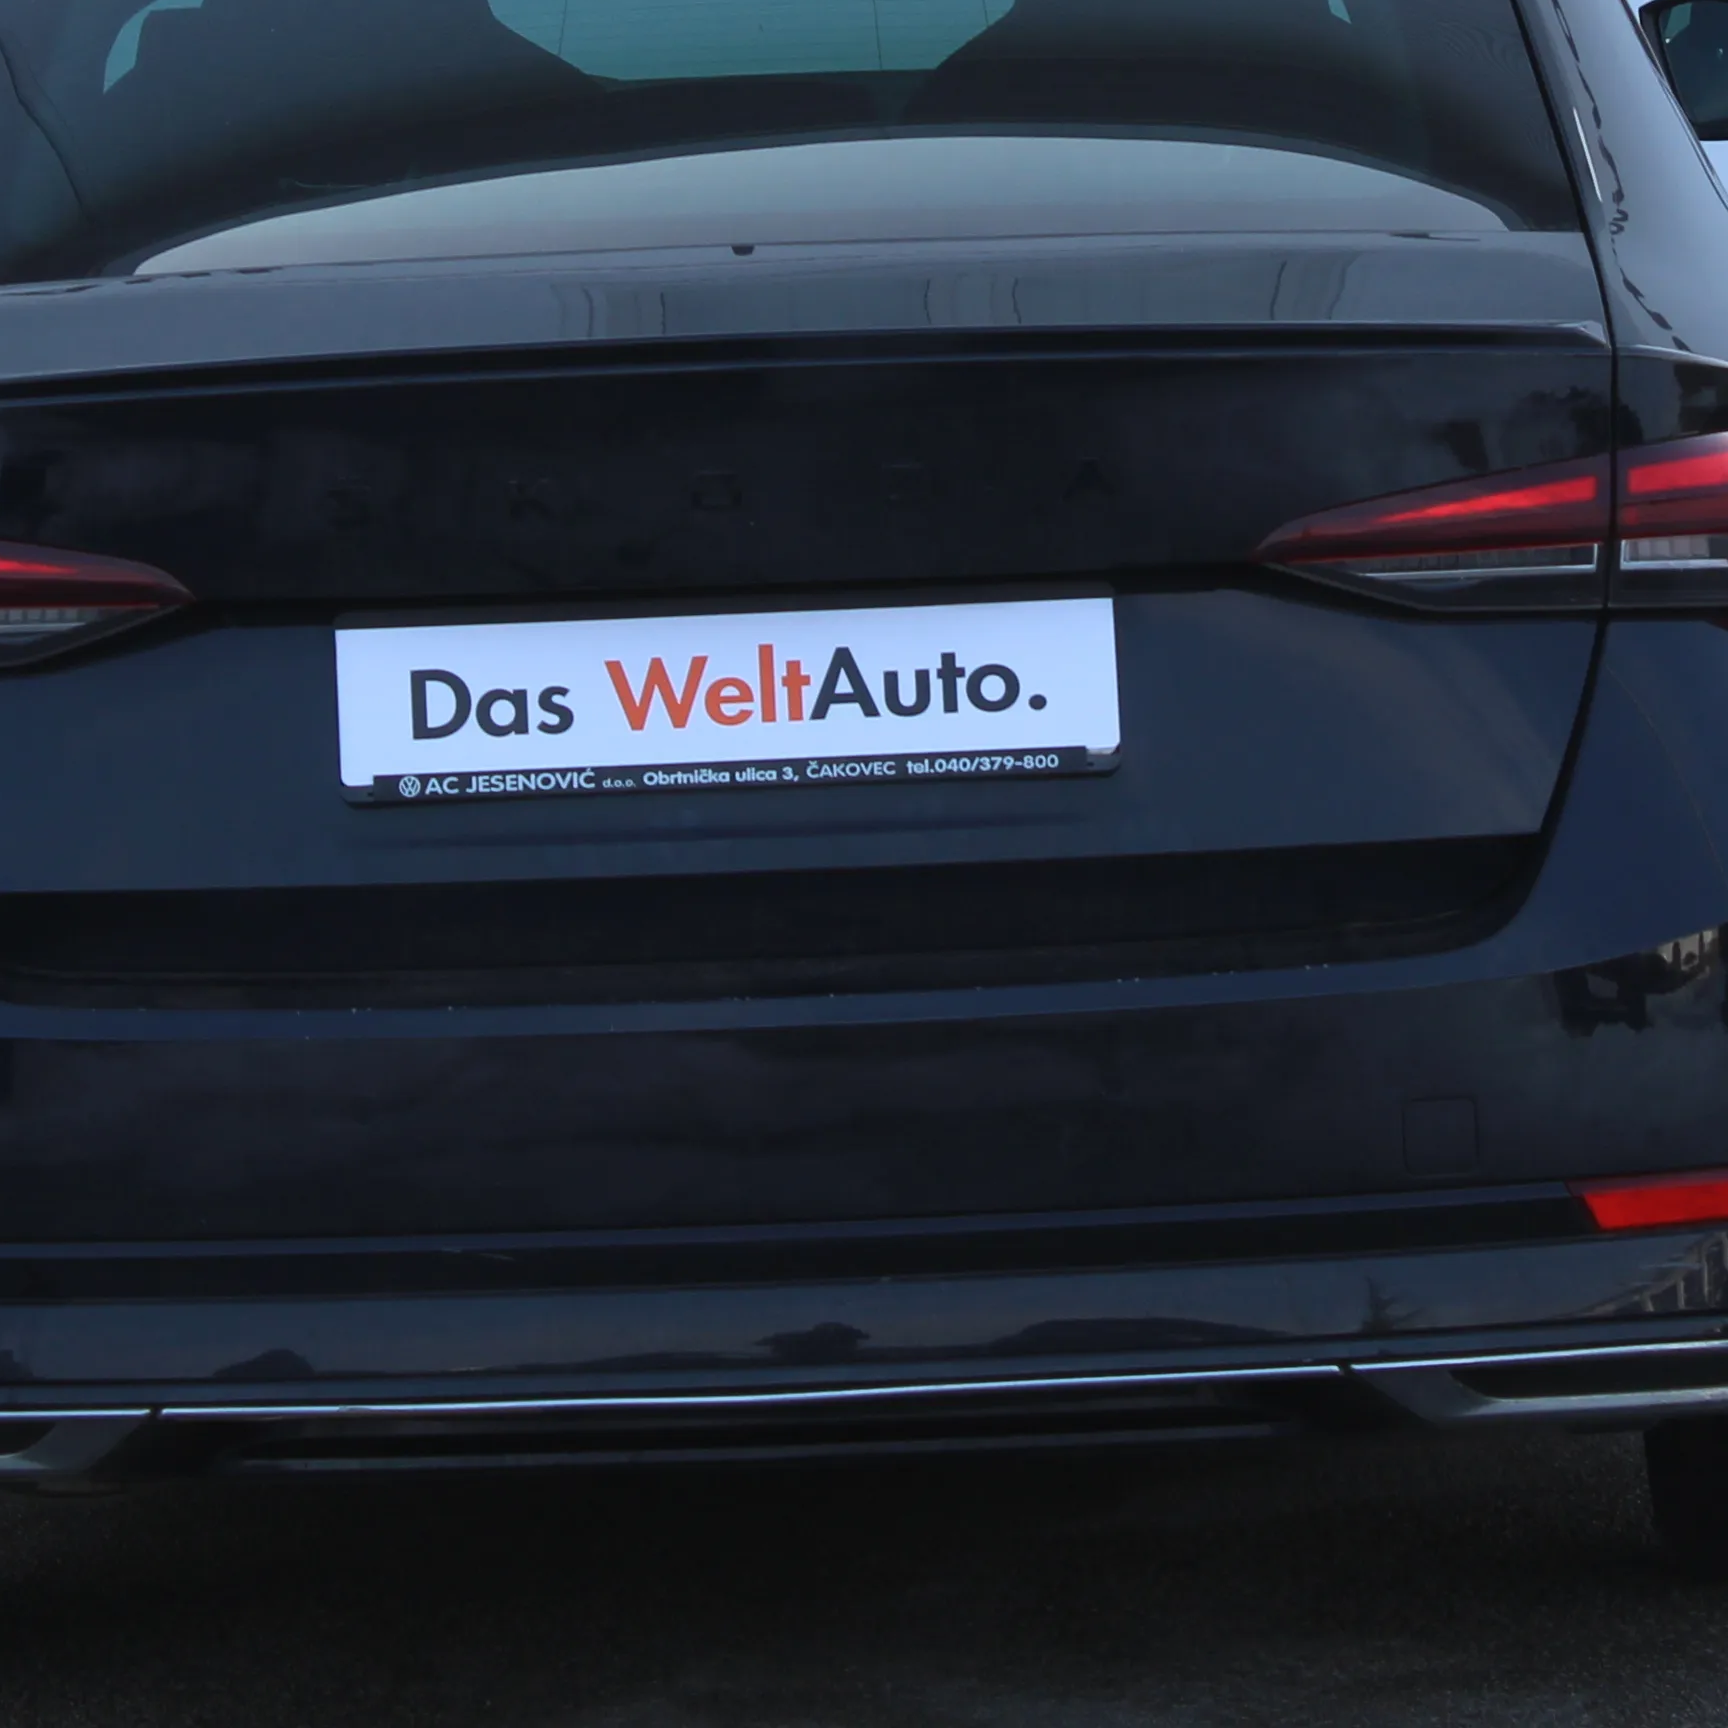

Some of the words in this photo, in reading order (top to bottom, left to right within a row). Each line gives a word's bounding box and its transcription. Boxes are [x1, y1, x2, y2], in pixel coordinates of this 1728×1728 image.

[410, 669, 574, 740] Das
[604, 644, 1048, 732] WeltAuto.
[424, 776, 460, 796] AC
[465, 767, 596, 794] JESENOVIĆ
[642, 768, 731, 786] Obrtnička
[735, 766, 777, 783] ulica
[781, 765, 800, 783] 3,
[805, 760, 897, 779] ČAKOVEC
[906, 753, 1060, 774] tel.040/379-800
